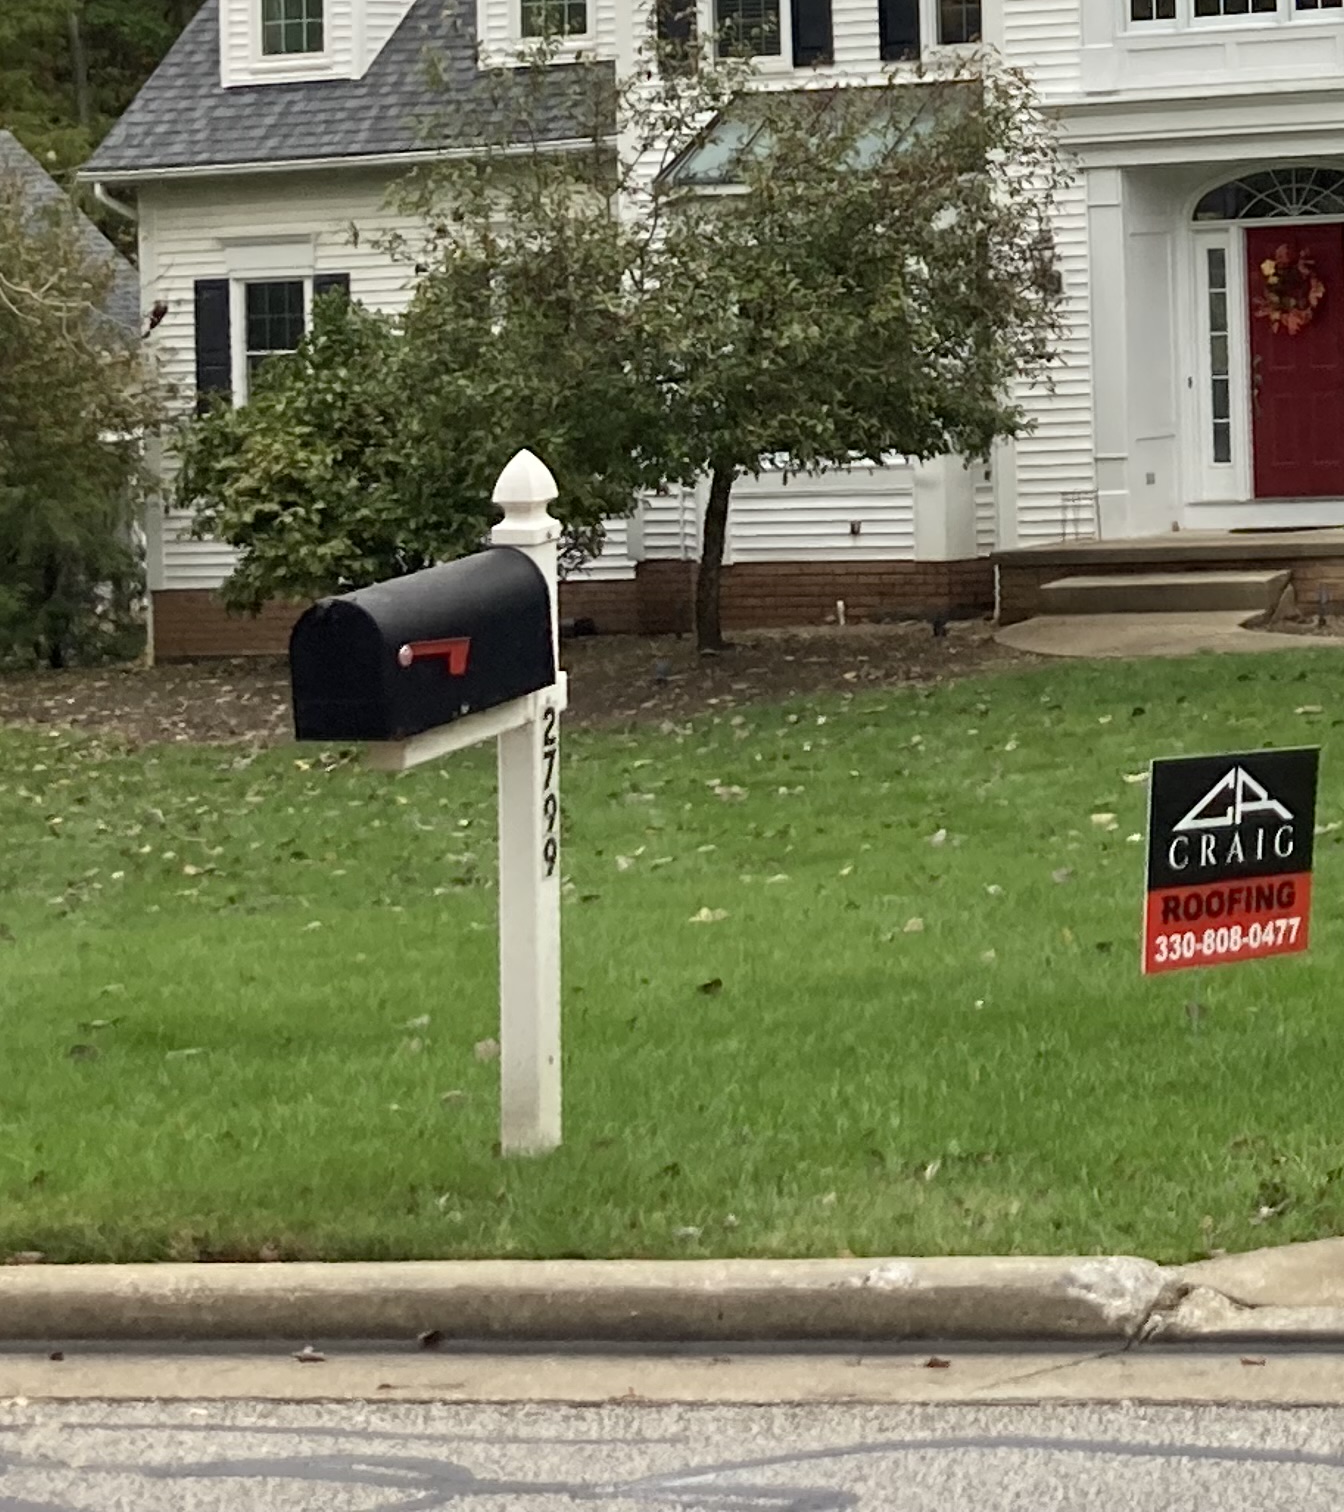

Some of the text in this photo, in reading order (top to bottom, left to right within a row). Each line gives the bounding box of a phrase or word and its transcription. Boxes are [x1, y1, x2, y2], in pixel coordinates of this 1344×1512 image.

[543, 706, 557, 876] 2799
[1168, 824, 1295, 870] CRAIG
[1162, 881, 1296, 925] ROOFING
[1155, 917, 1301, 963] 330-808-0477
